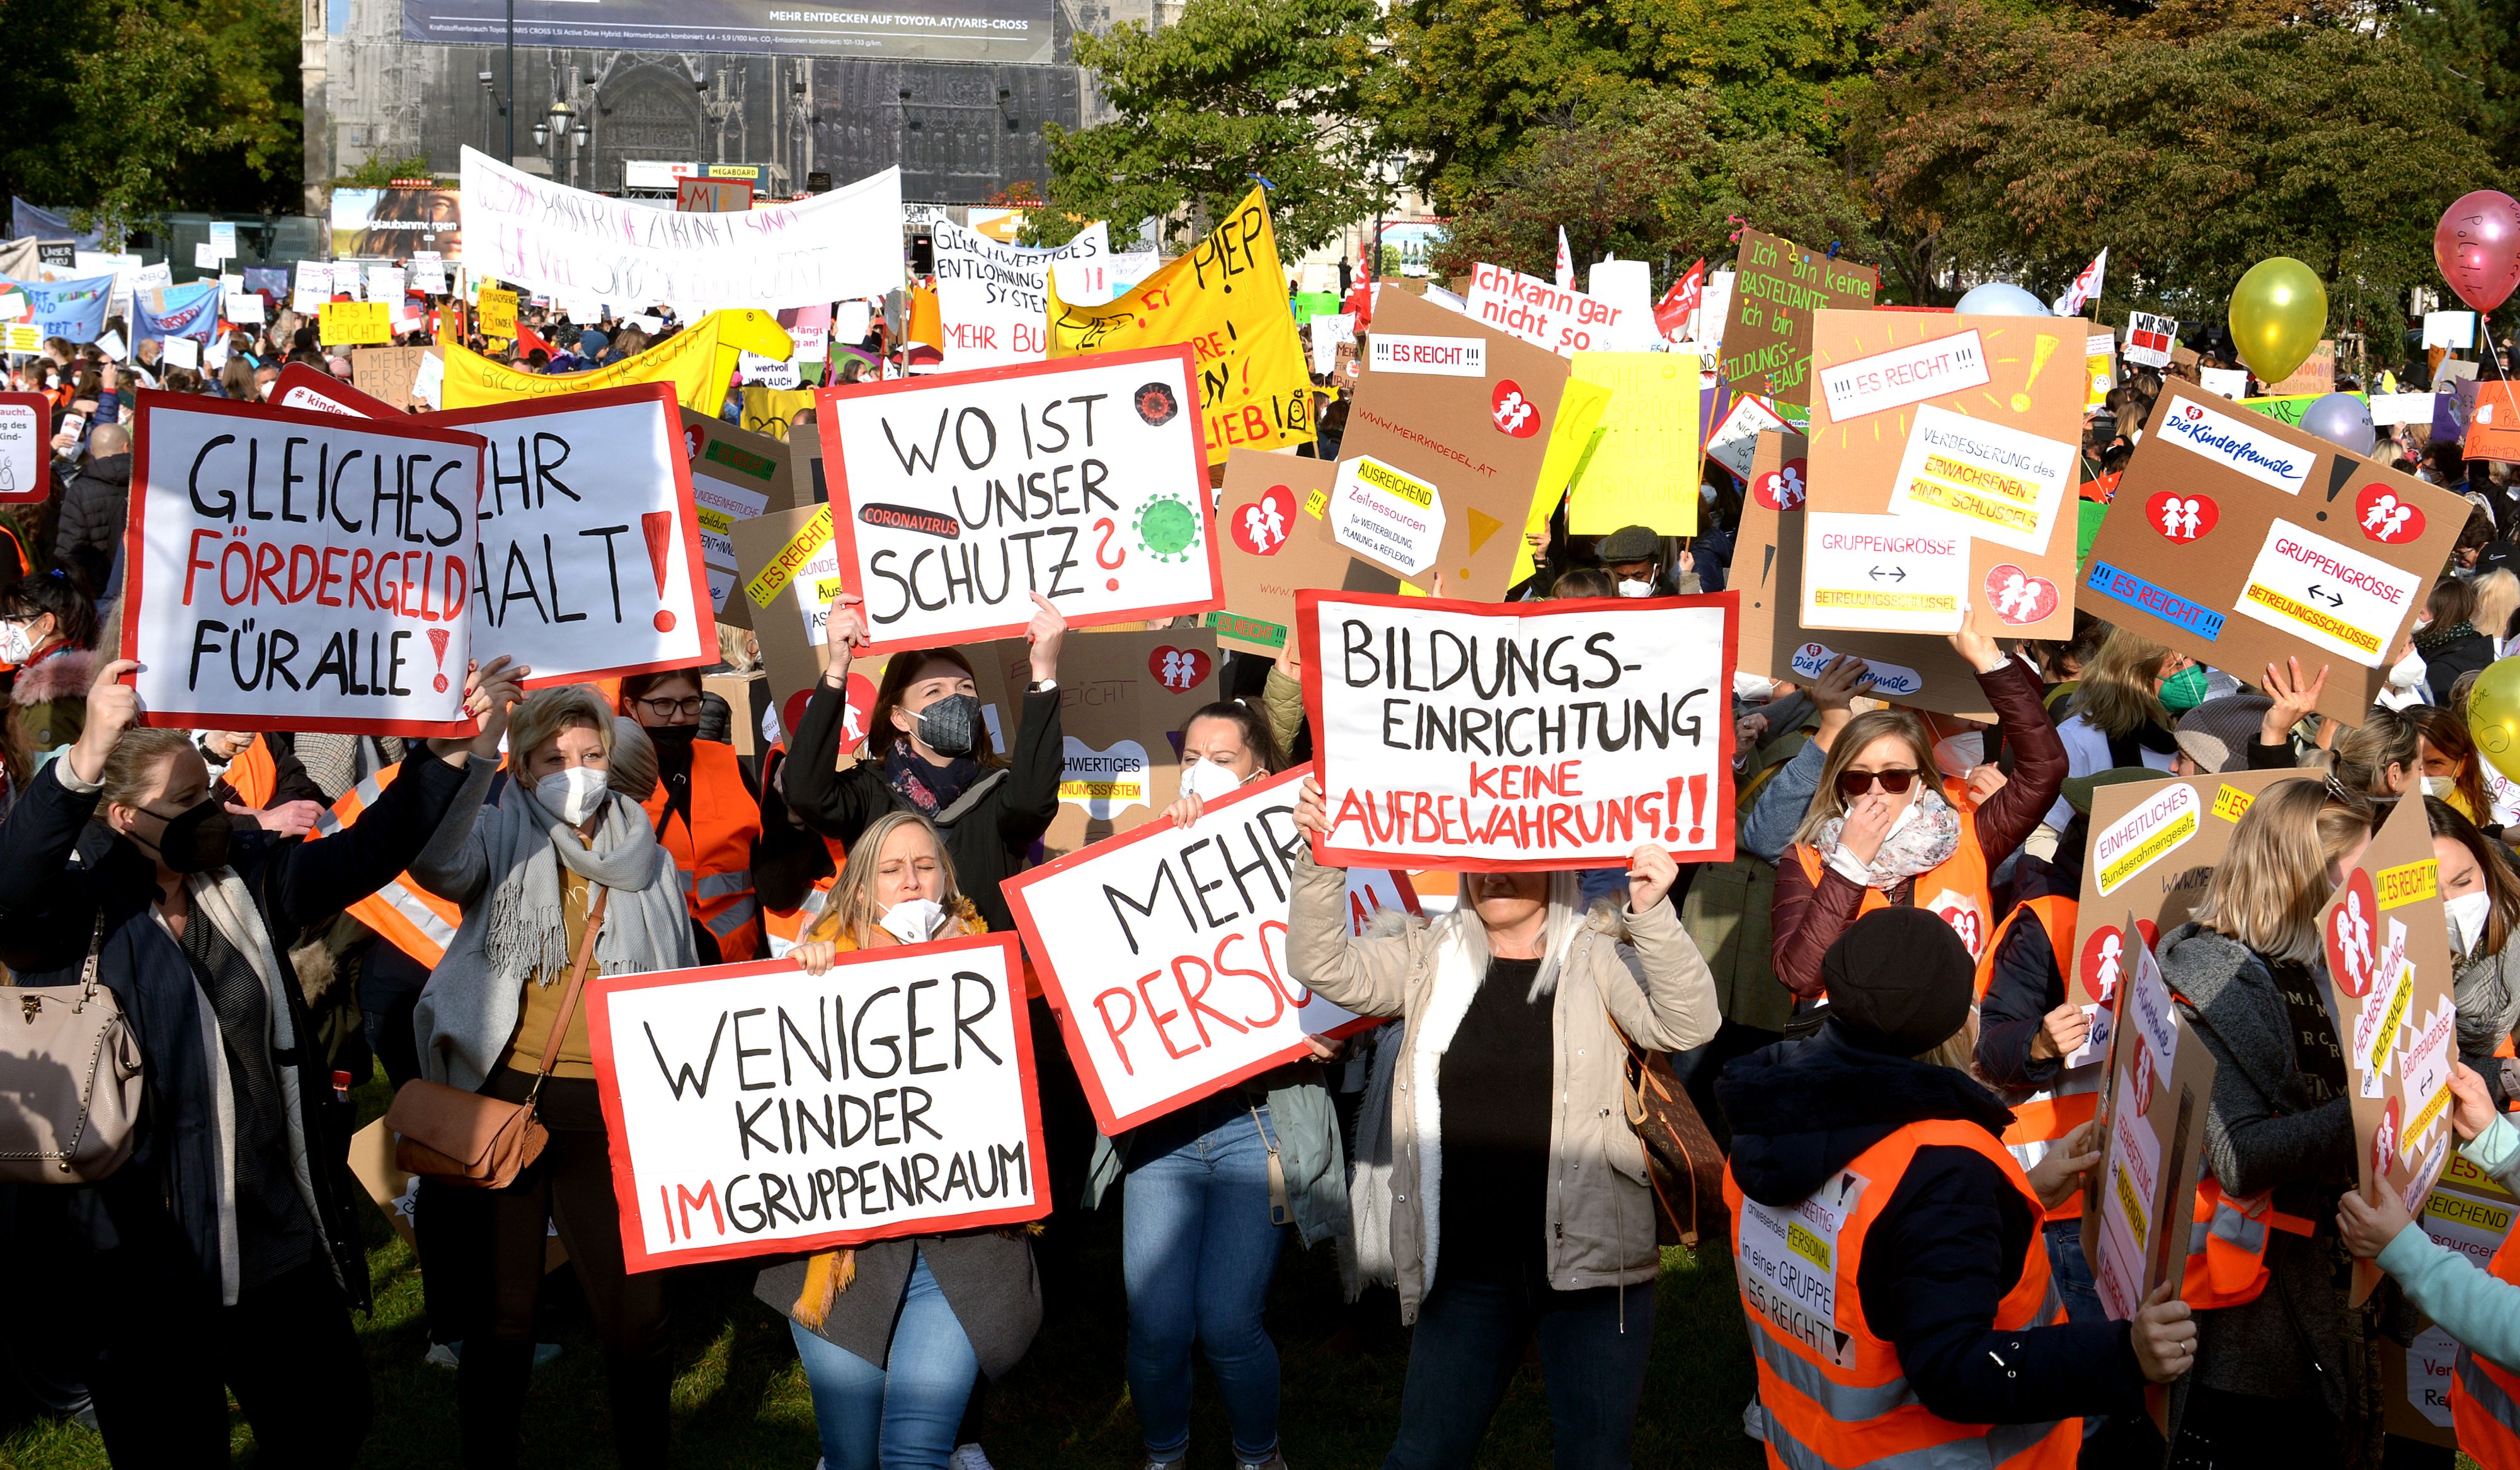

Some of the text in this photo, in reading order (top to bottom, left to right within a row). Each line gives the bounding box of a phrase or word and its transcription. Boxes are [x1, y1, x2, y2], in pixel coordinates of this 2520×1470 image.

[623, 31, 670, 40] Normverbrauch
[769, 11, 1028, 30] MEHR ENTDECKEN AUF TOYOTA.AT/YARIS-CROSS
[712, 168, 757, 176] MEGABOARD
[41, 246, 72, 257] UNSER
[1750, 240, 1870, 299] Ich bin keine
[338, 304, 360, 318] ES
[1470, 261, 1622, 327] Ich kann gar
[1739, 270, 1830, 312] BASTELTANTE
[1741, 297, 1794, 336] ich bin
[327, 324, 381, 340] REICHT
[481, 312, 512, 331] 25 KINDER
[803, 339, 819, 348] an!
[943, 322, 998, 350] MEHR
[1482, 299, 1590, 350] nicht so
[2136, 313, 2175, 336] WIR SIND
[370, 350, 418, 369] MEHR
[481, 366, 591, 394] BILDUNG
[755, 364, 788, 372] wertvoll
[1377, 343, 1479, 367] !!! ES REICHT !!!
[1833, 348, 1975, 402] !!! ES REICHT !!!
[767, 377, 792, 386] AUCH
[10, 422, 27, 430] des
[881, 393, 1109, 476] WO IST
[1358, 407, 1496, 479] WWW.MEHRKNOEDEL.AT
[2166, 415, 2303, 479] Die Kinderfreunde
[718, 444, 732, 462] ES
[1923, 426, 2056, 478] VERBESSERUNG des
[1924, 456, 2027, 499] ERWACHSENEN
[188, 433, 462, 548] GLEICHES
[953, 458, 1119, 531] UNSER
[1348, 485, 1427, 534] Zeitressourcen
[1358, 462, 1433, 507] AUSREICHEND
[1910, 479, 2037, 531] KIND SCHLÜSSELS
[864, 507, 959, 536] CORONAVIRUS
[1343, 526, 1415, 568] PLANUNG & REFLEXION
[1360, 517, 1414, 550] WEITERBILDUNG,
[1822, 534, 1956, 556] GRUPPENGRÖSSE
[181, 524, 466, 624] FÖRDERGELD
[748, 520, 827, 604] !!! ES REICHT
[2276, 538, 2404, 605] GRUPPENGRÖSSE
[2090, 565, 2203, 626] !!! ES REICHT
[2247, 583, 2379, 653] BETREUUNGSSCHLÜSSEL
[1218, 614, 1233, 633] ES
[1234, 619, 1274, 641] REICHT
[189, 617, 301, 692] FÜR
[1343, 618, 1642, 701] BILDUNGS-
[1792, 655, 1815, 670] Die
[1383, 687, 1709, 758] EINRICHTUNG
[1469, 759, 1584, 800] KEINE
[1326, 772, 1709, 851] AUFBEWAHRUNG!!
[2099, 787, 2189, 860] EINHEITLICHES
[2099, 815, 2196, 888] Bundesrahmengesetz
[1102, 805, 1303, 956] MEHR
[2386, 866, 2426, 901] ES REICHT
[2354, 936, 2405, 1060] HERABSETZUNG
[642, 970, 1003, 1102] WENIGER
[2363, 973, 2413, 1096] der KINDERANZAHL
[2402, 1013, 2451, 1081] GRUPPENGRÖSSE
[735, 1086, 943, 1161] KINDER
[2118, 1111, 2153, 1203] HERABSETZUNG
[660, 1140, 1029, 1244] IM GRUPPENRAUM
[1747, 1203, 1830, 1268] anwesendes PERSONAL
[1742, 1237, 1831, 1316] in einer GRUPPE
[1748, 1277, 1766, 1314] ES
